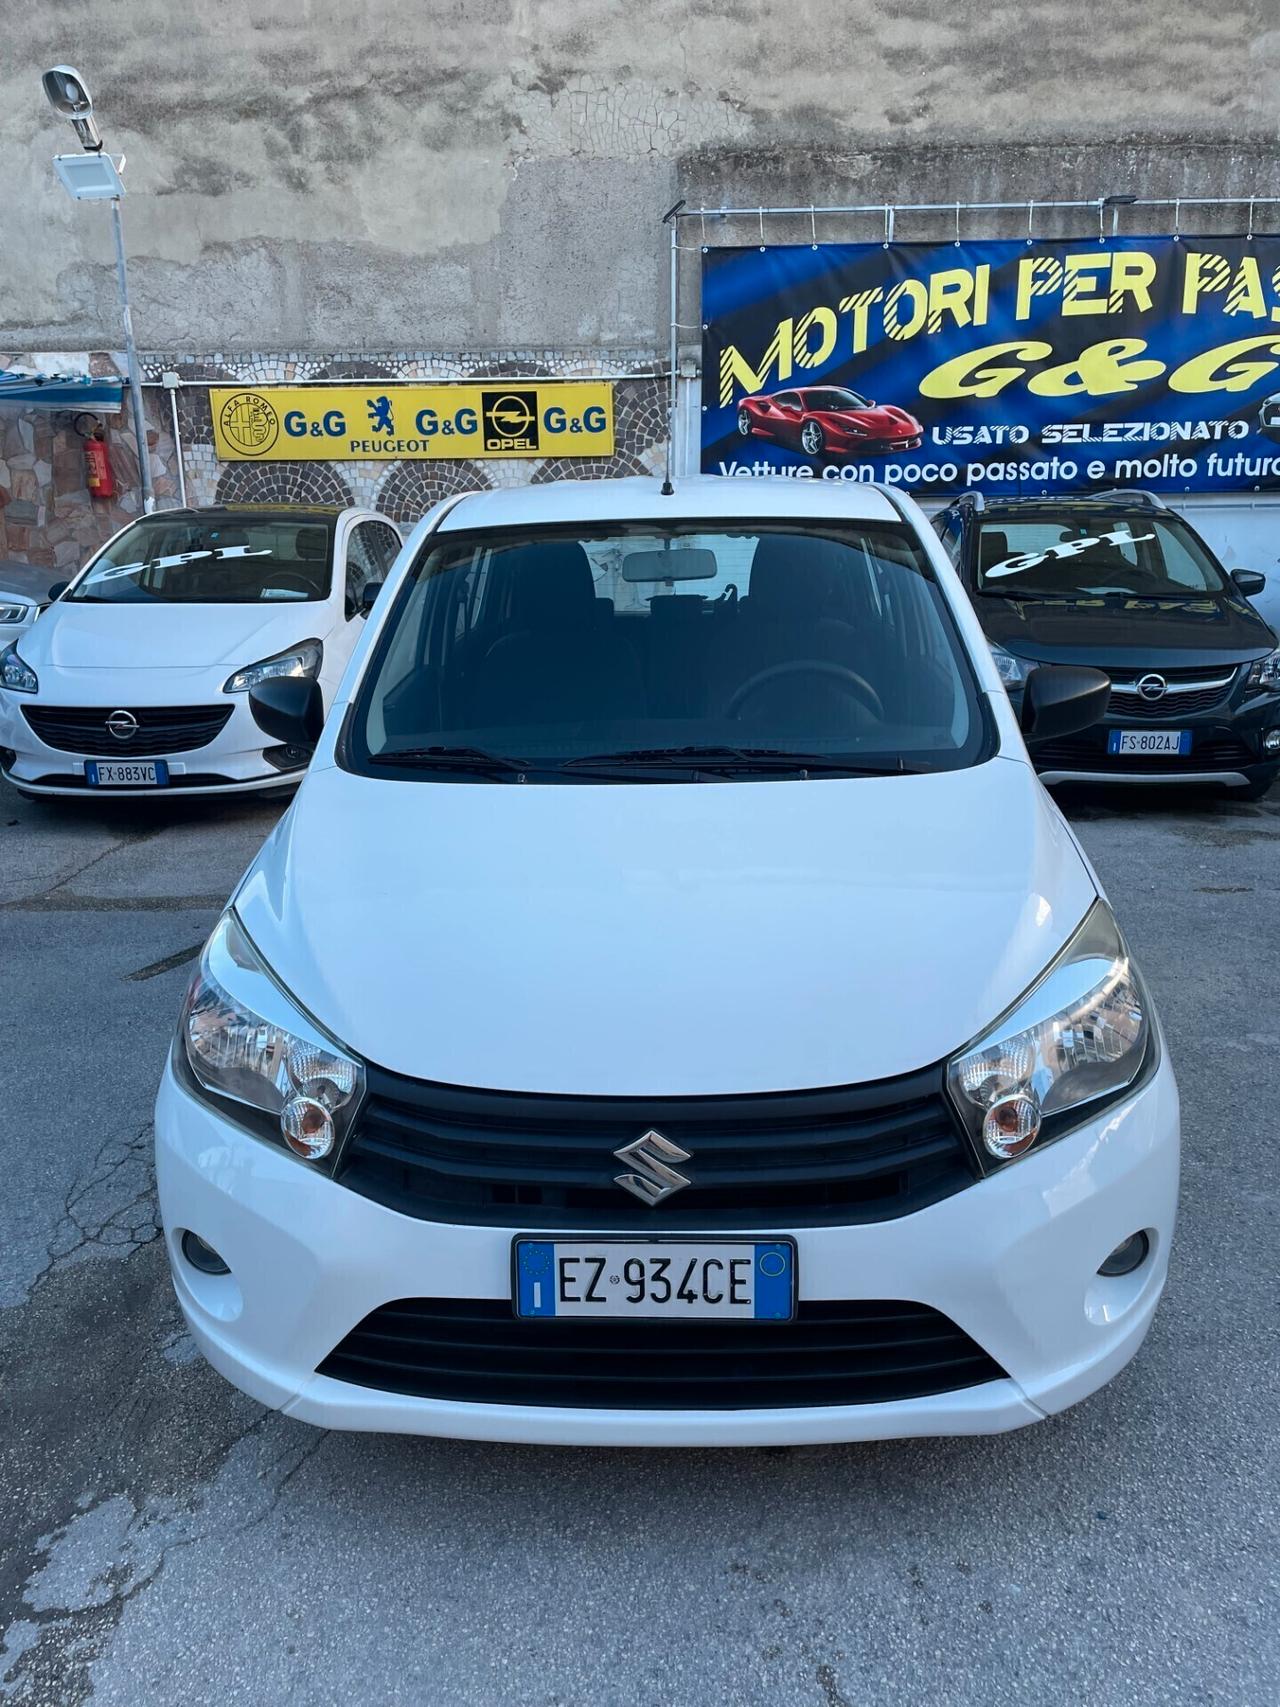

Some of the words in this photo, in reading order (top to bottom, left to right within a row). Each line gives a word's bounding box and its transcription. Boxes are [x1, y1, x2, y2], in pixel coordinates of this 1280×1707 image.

[719, 263, 990, 409] MOTORI
[1015, 251, 1157, 321] PER
[1182, 251, 1280, 323] PA
[918, 335, 1280, 399] G&G
[223, 399, 240, 427] ALFA
[245, 395, 276, 425] ROMEO
[284, 410, 346, 437] G&G
[416, 408, 478, 436] G&G
[543, 406, 607, 434] G&G
[350, 439, 429, 453] PEUGEOT
[486, 438, 537, 451] OPEL
[931, 425, 1029, 447] USATO
[1041, 421, 1250, 446] SELEZIONATO
[718, 460, 813, 478] Vetture
[822, 463, 875, 482] con
[884, 462, 957, 485] poco
[966, 455, 1077, 487] passato
[1087, 460, 1106, 480] e
[1114, 454, 1196, 480] molto
[83, 545, 273, 586] GPL
[985, 530, 1156, 578] GPL
